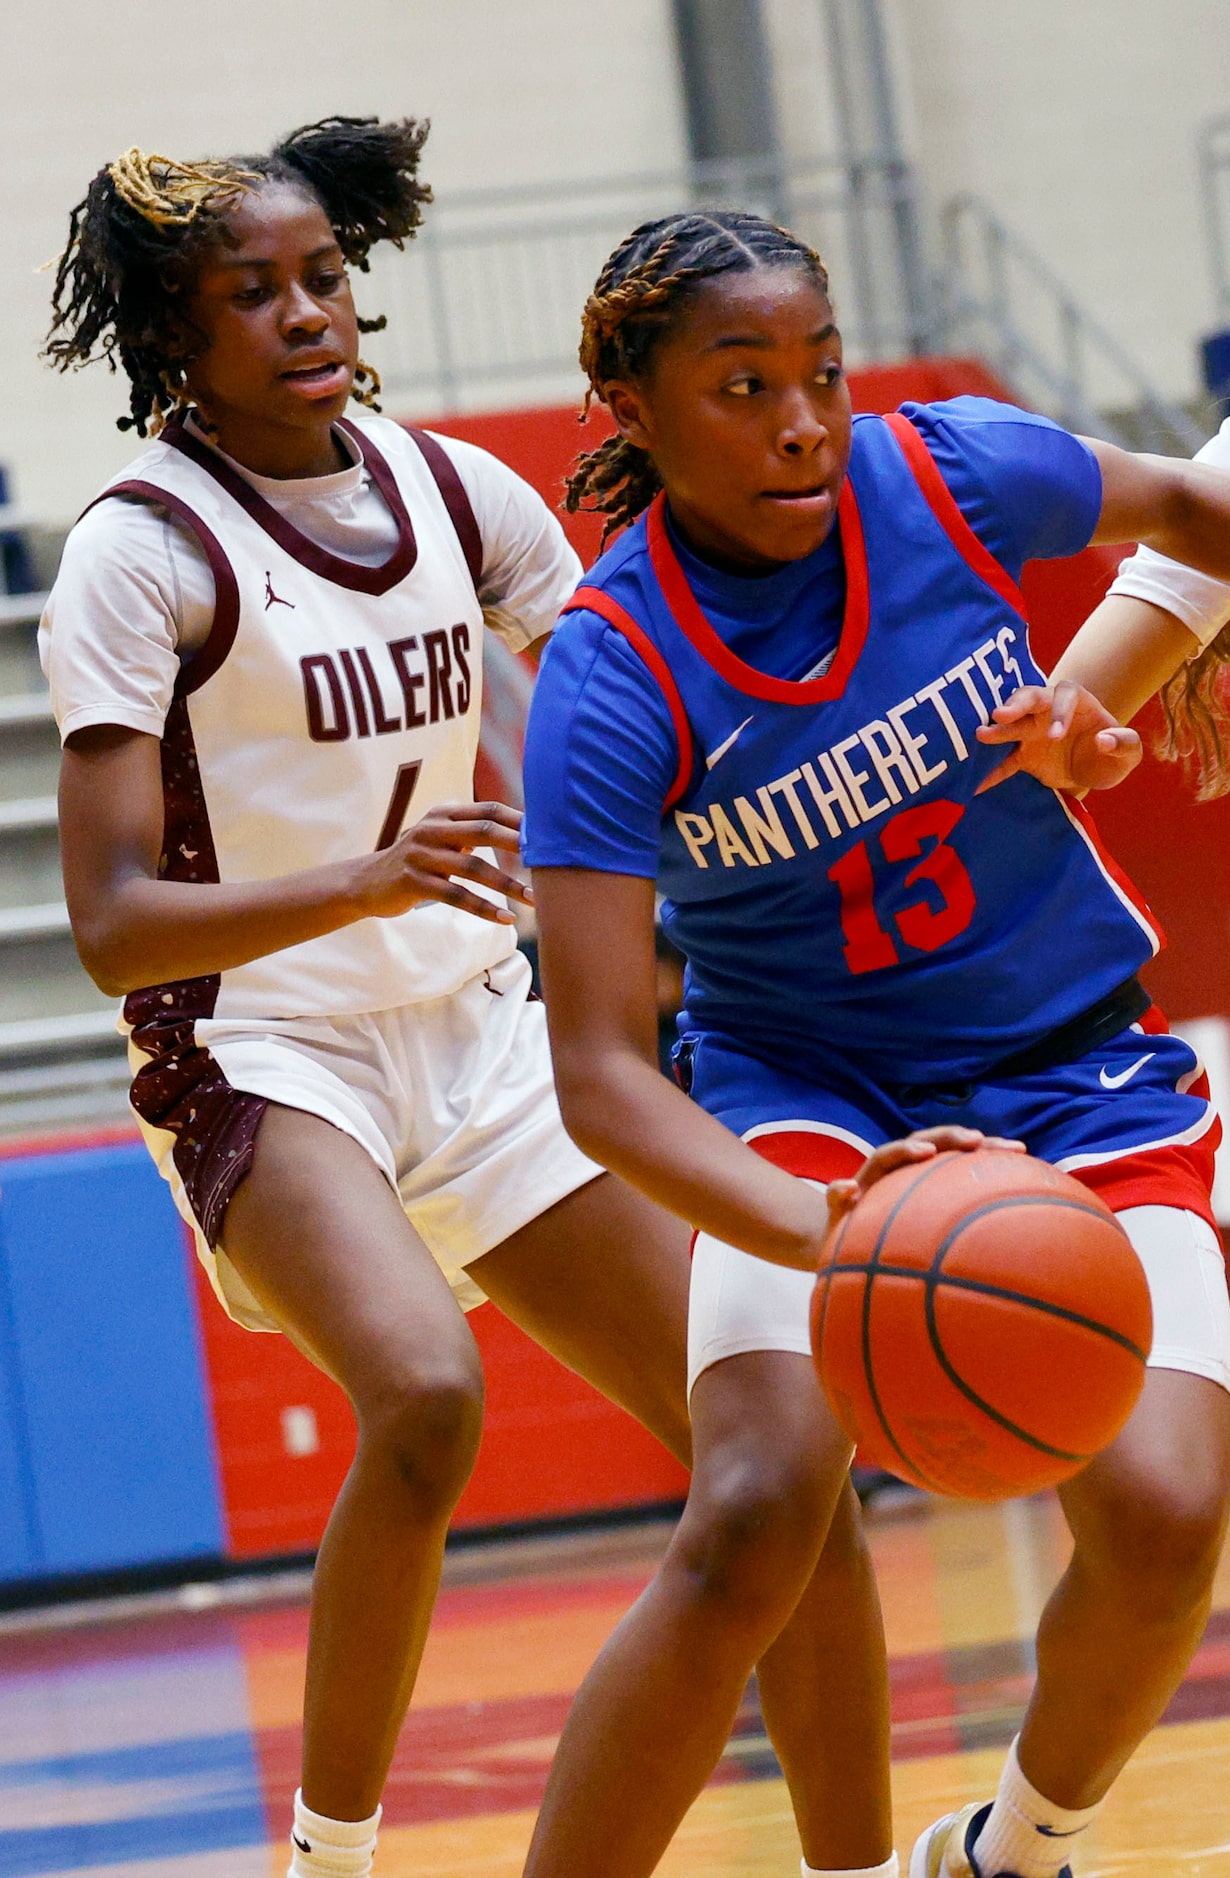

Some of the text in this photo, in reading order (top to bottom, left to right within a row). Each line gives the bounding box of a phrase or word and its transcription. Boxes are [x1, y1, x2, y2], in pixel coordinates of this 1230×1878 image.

[299, 622, 472, 743] OILERS
[674, 626, 1025, 869] PANTHERETTES
[827, 798, 976, 976] 13
